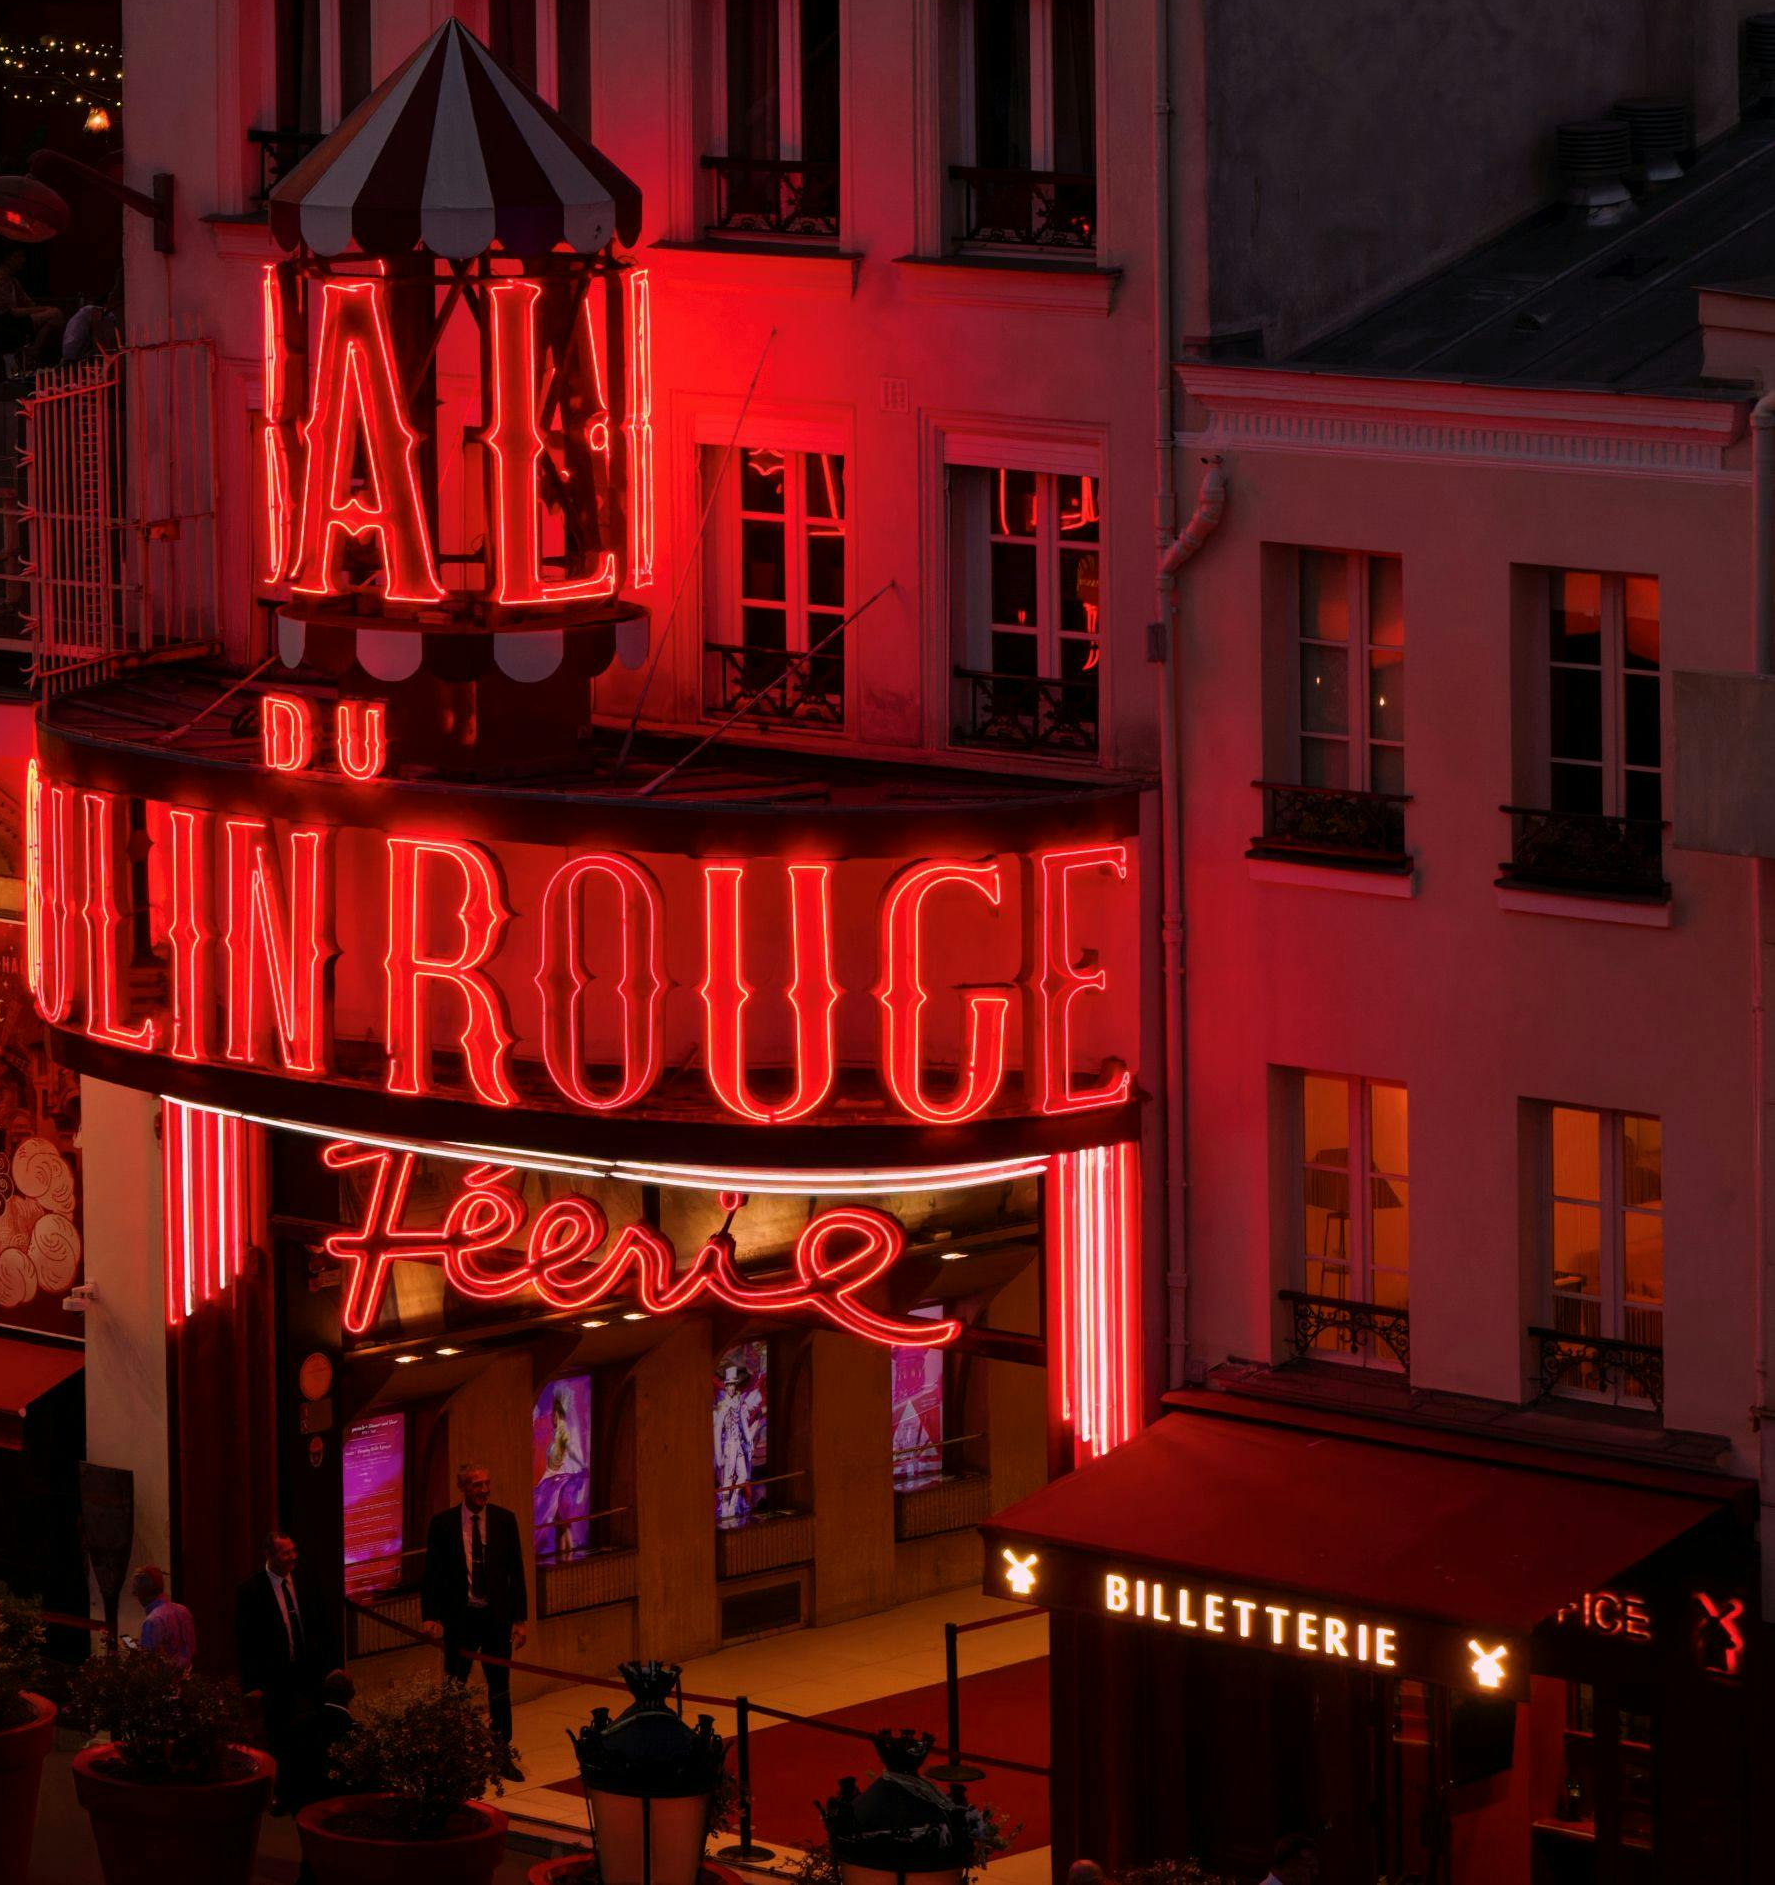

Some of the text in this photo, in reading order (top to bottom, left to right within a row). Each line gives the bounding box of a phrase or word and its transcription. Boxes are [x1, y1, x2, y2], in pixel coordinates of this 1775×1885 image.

[262, 695, 388, 782] DU
[26, 758, 1132, 1125] ULIN ROUGE
[322, 1140, 964, 1348] Féerie
[1105, 1574, 1396, 1667] BILLETTERIE
